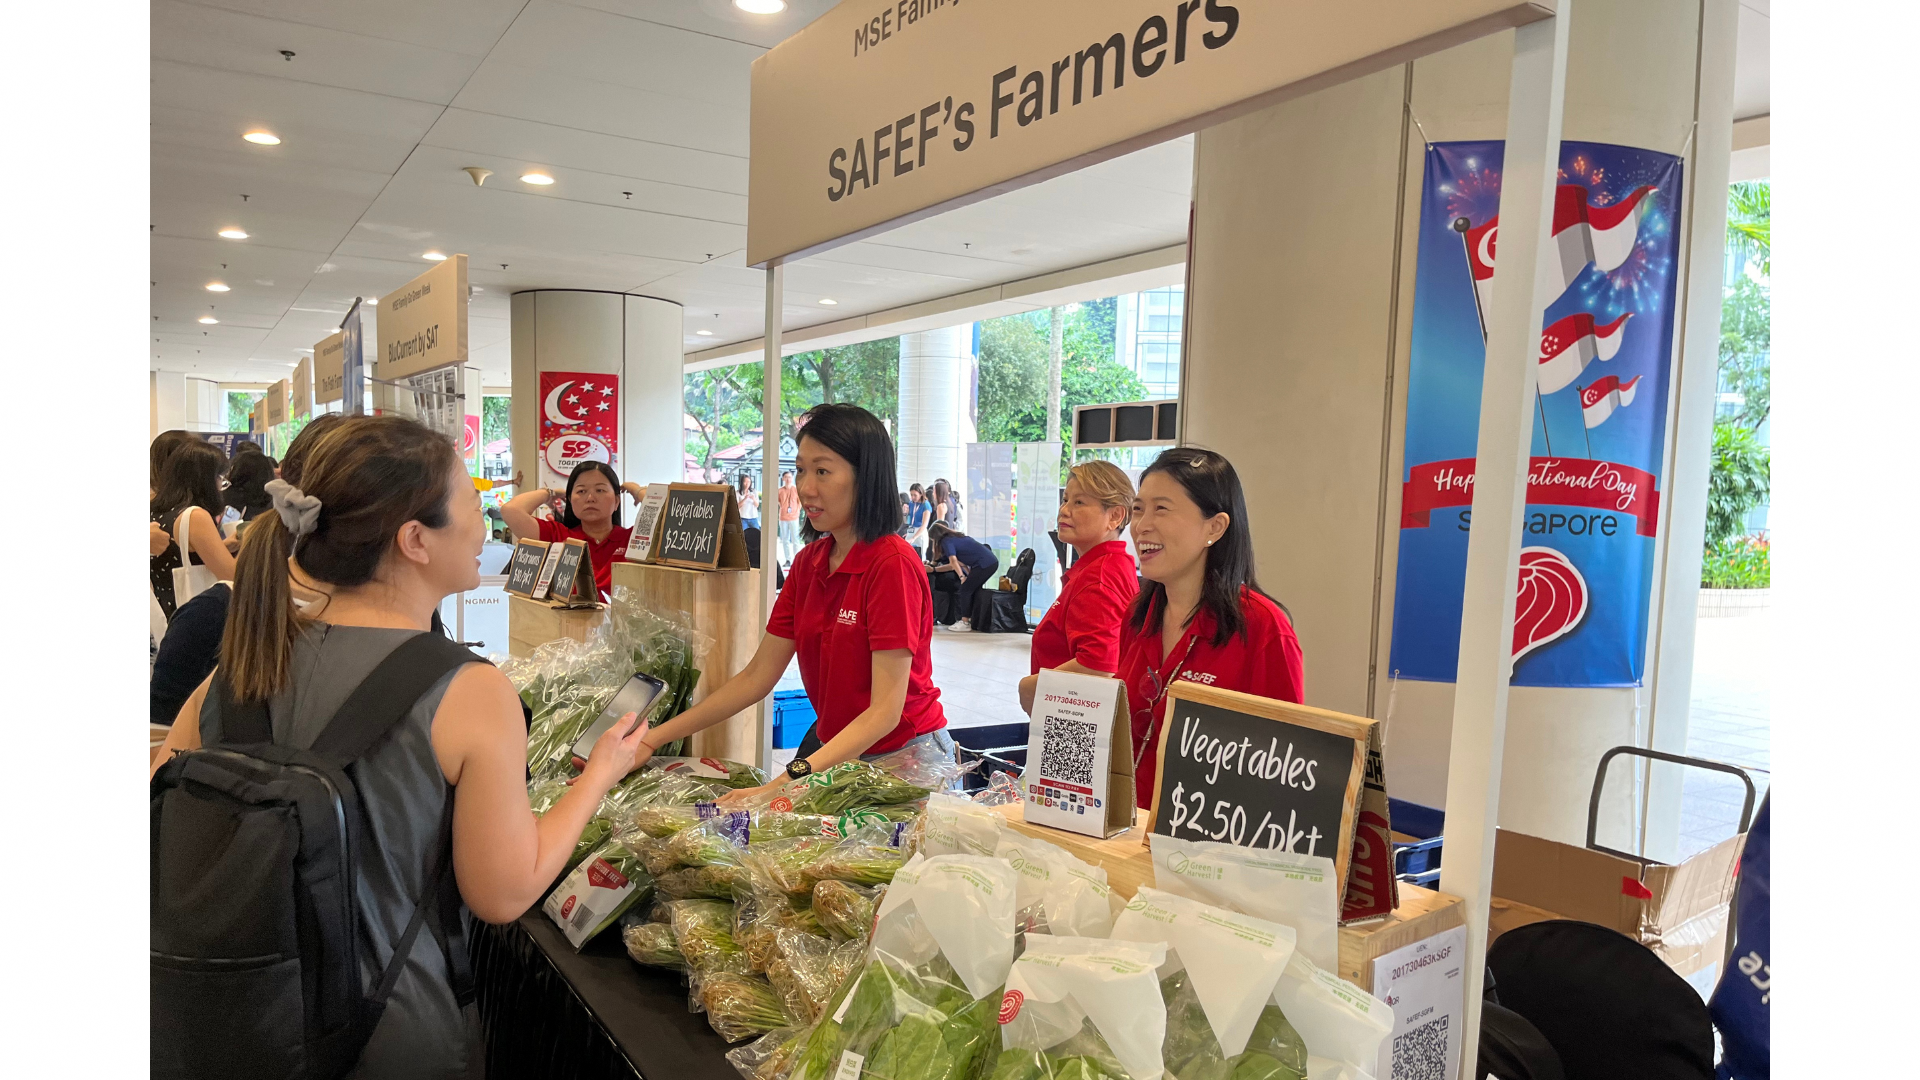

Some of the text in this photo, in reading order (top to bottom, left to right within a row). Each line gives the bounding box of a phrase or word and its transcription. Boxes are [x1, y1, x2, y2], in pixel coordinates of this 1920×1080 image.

[854, 0, 959, 57] MSE Fam
[990, 0, 1240, 139] Farmers
[388, 324, 439, 363] BluCurrent by SAT
[1527, 460, 1609, 489] ational
[1602, 469, 1637, 510] Day
[670, 496, 715, 526] Vegetables
[665, 528, 713, 559] $2.50/pkt
[1044, 693, 1101, 709] 201730463KSGF
[1180, 716, 1318, 791] Vegetables
[1168, 781, 1322, 857] $2.50/pkt
[608, 871, 620, 883] FREE
[1020, 869, 1042, 880] Harvest
[1025, 862, 1043, 874] Green
[1186, 869, 1212, 879] Harvest
[1190, 861, 1212, 871] Green
[1142, 911, 1165, 922] Harvest
[1147, 904, 1168, 914] Green
[1391, 946, 1452, 980] 201730463KSGF
